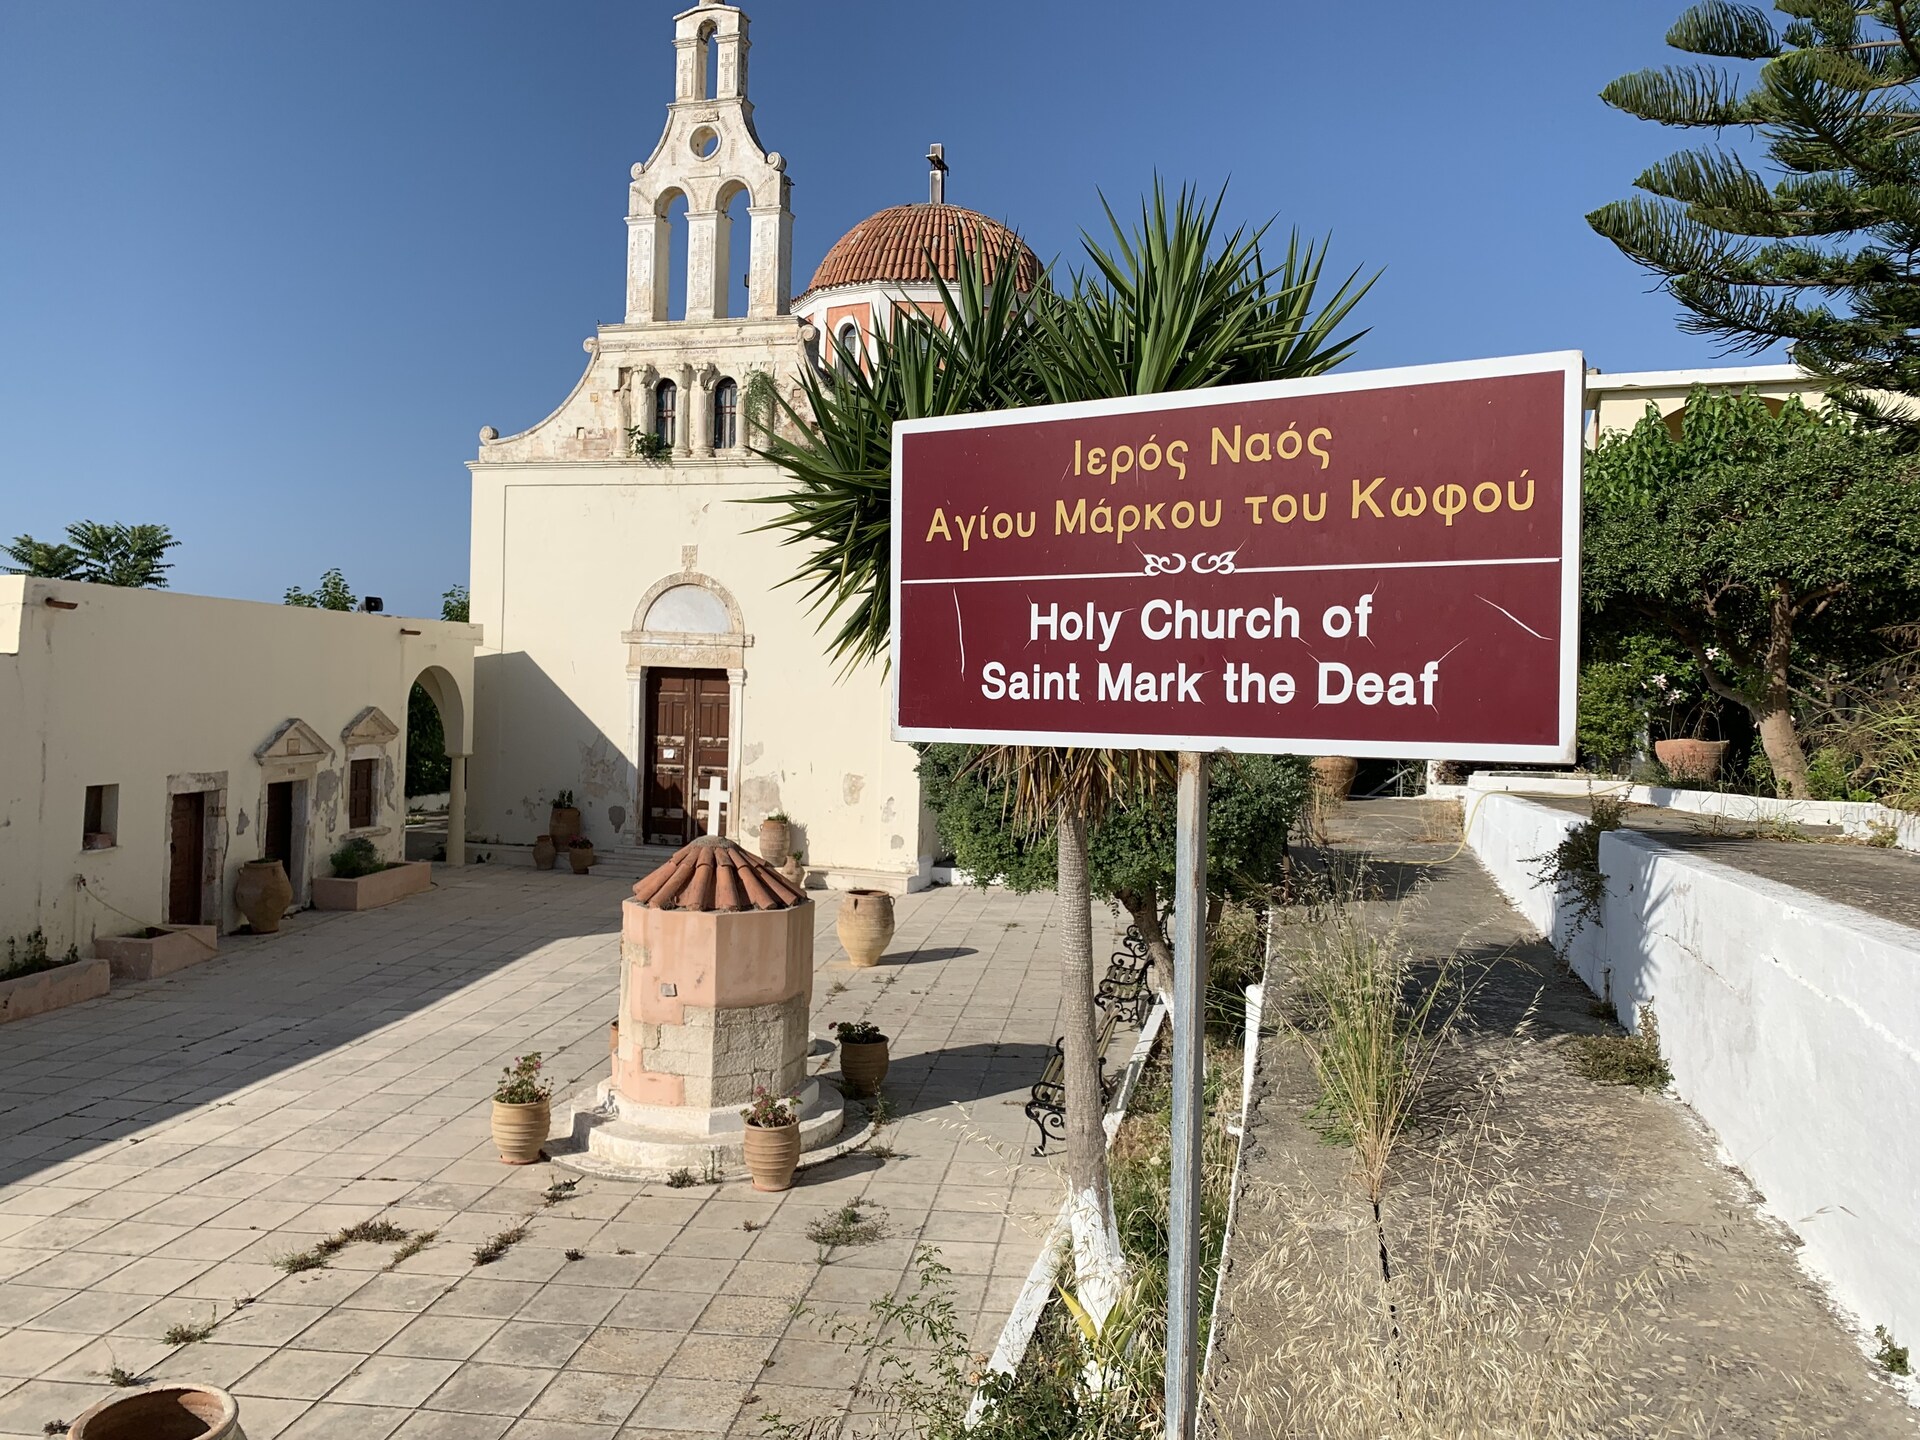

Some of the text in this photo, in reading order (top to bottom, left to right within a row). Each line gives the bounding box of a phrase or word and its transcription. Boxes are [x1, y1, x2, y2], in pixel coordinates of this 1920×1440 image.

[1074, 421, 1333, 484] Ιερός Ναός
[925, 470, 1536, 551] Αγίου Μάρκου του Κωφού
[1029, 594, 1374, 651] Holy Church of
[981, 660, 1439, 707] Saint Mark the Deaf
